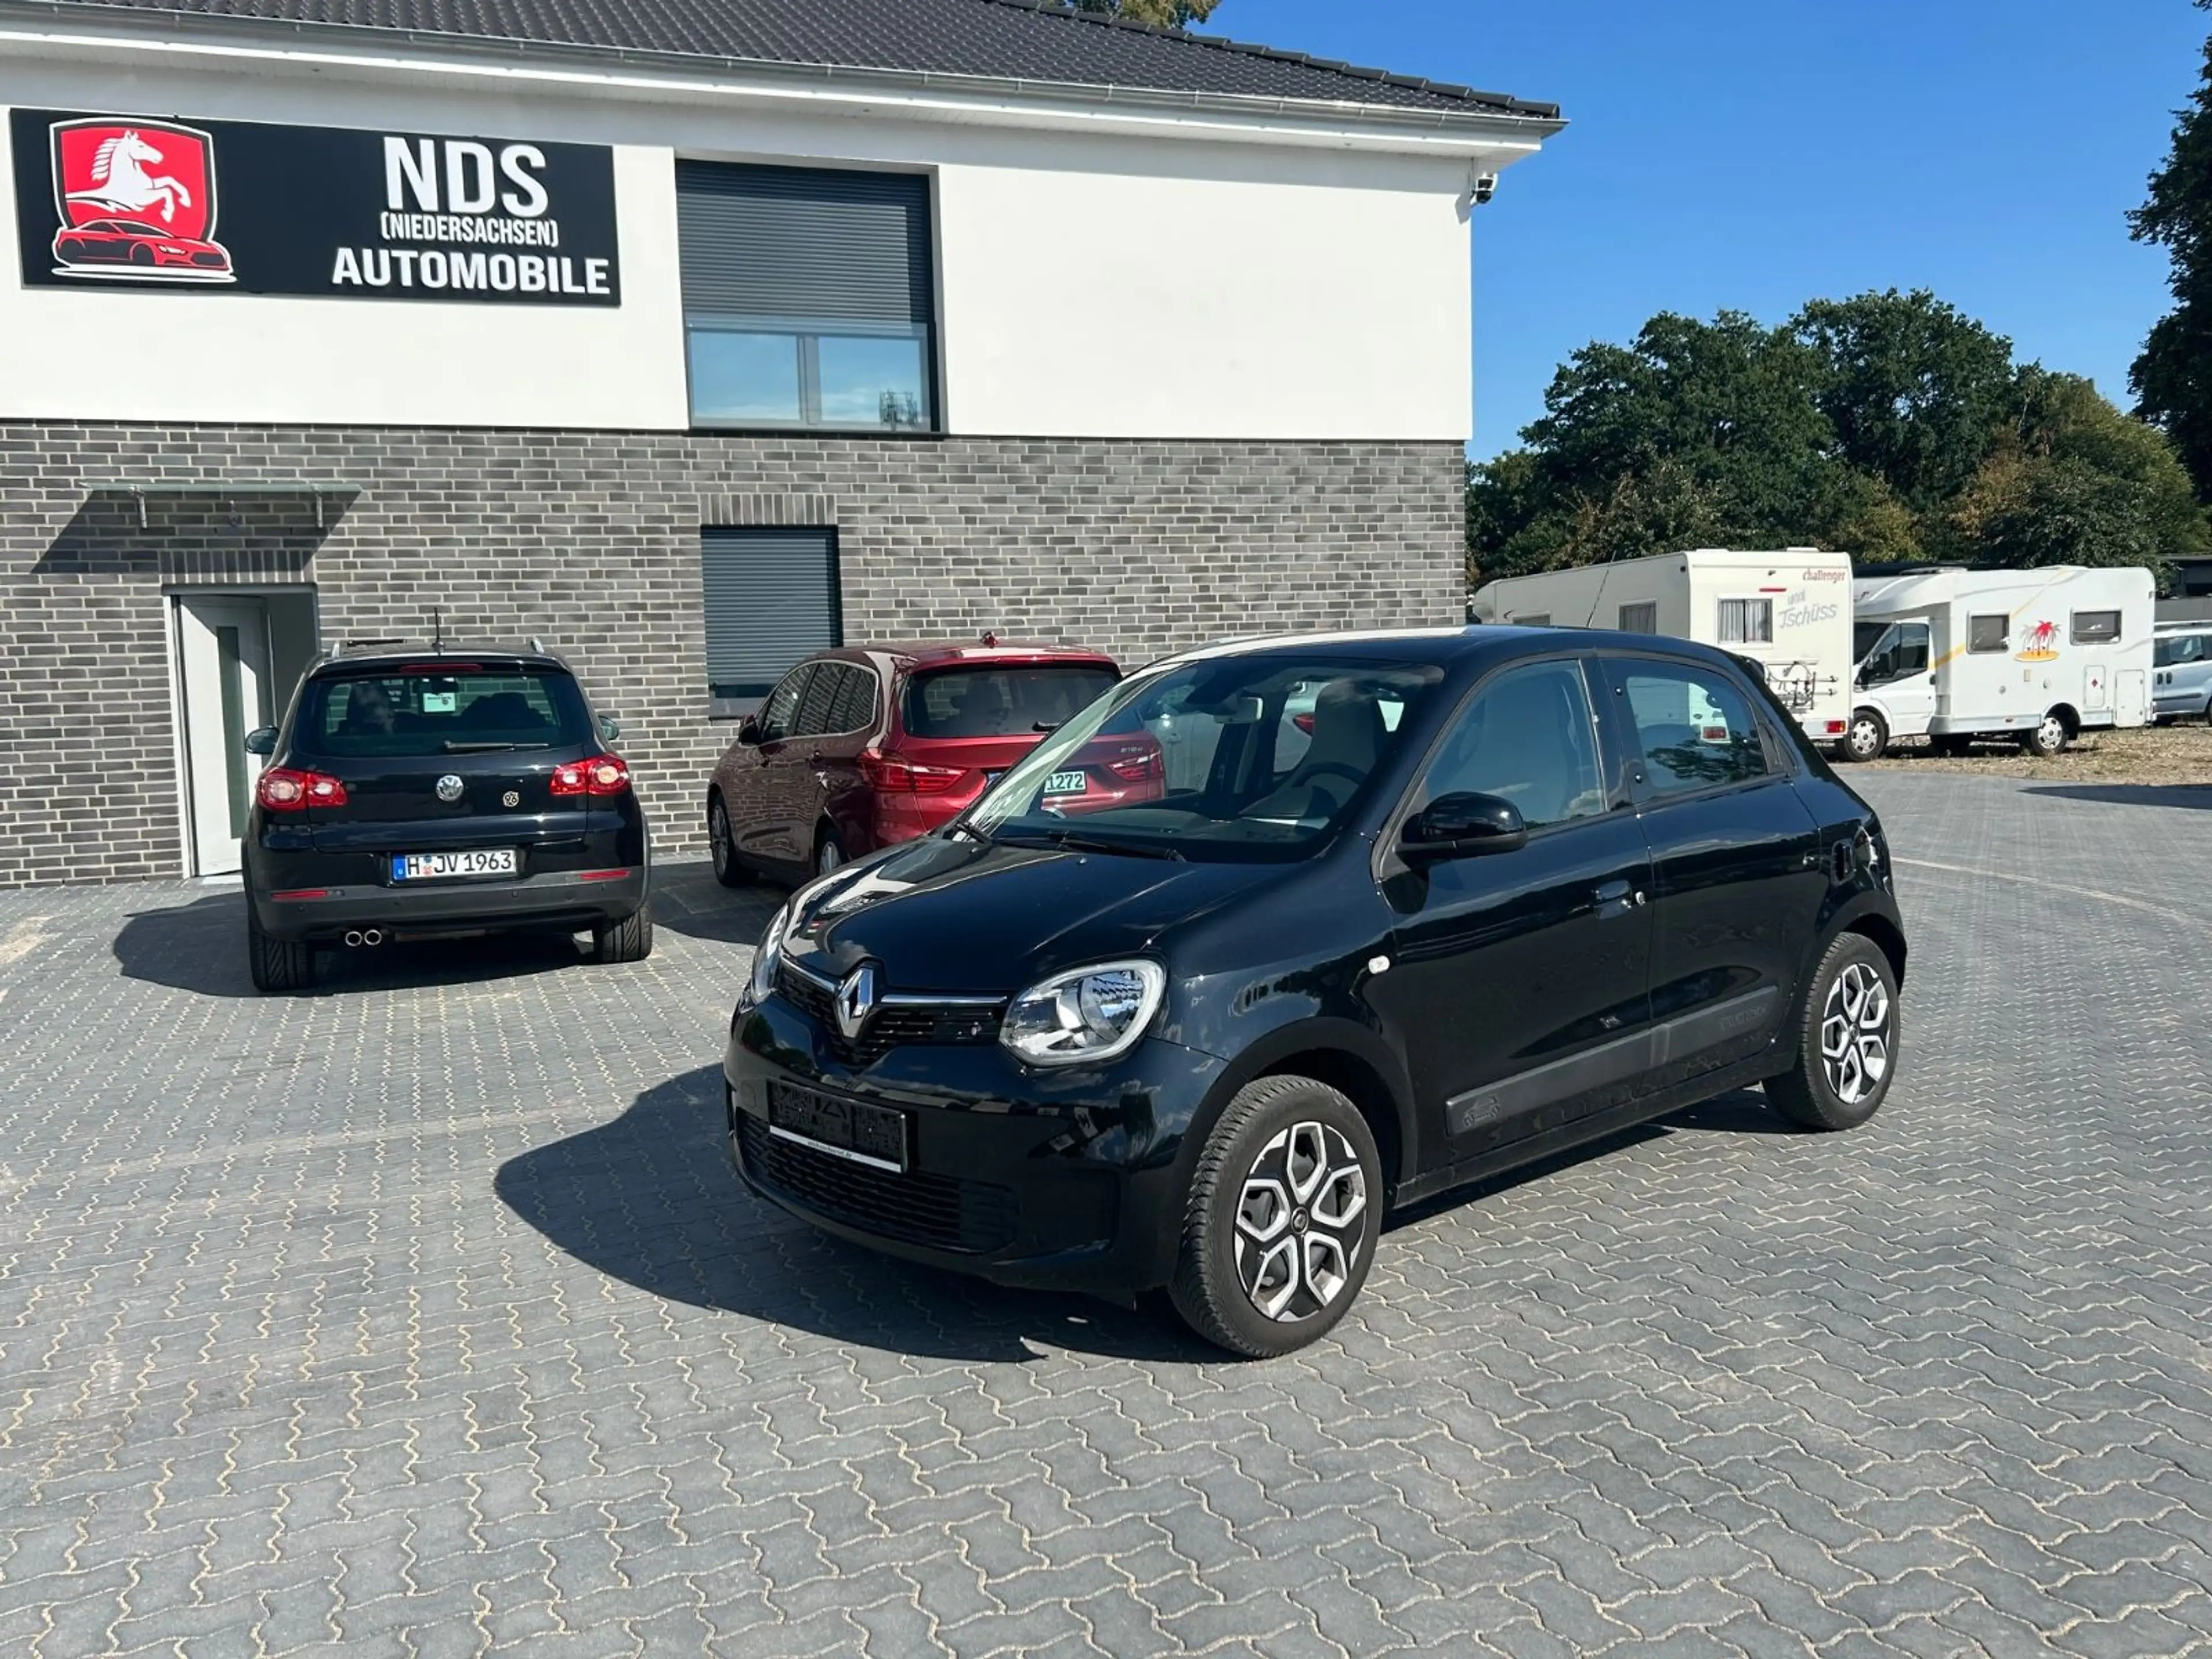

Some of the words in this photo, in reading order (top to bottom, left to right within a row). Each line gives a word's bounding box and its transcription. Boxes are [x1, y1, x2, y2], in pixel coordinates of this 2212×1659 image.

[383, 136, 549, 217] NDS
[380, 211, 559, 247] (NIEDERSACHSEN)
[332, 247, 611, 294] AUTOMOBILE
[1048, 773, 1084, 790] 1272
[407, 857, 420, 874] H
[434, 855, 459, 873] JV
[464, 852, 512, 872] 1963
